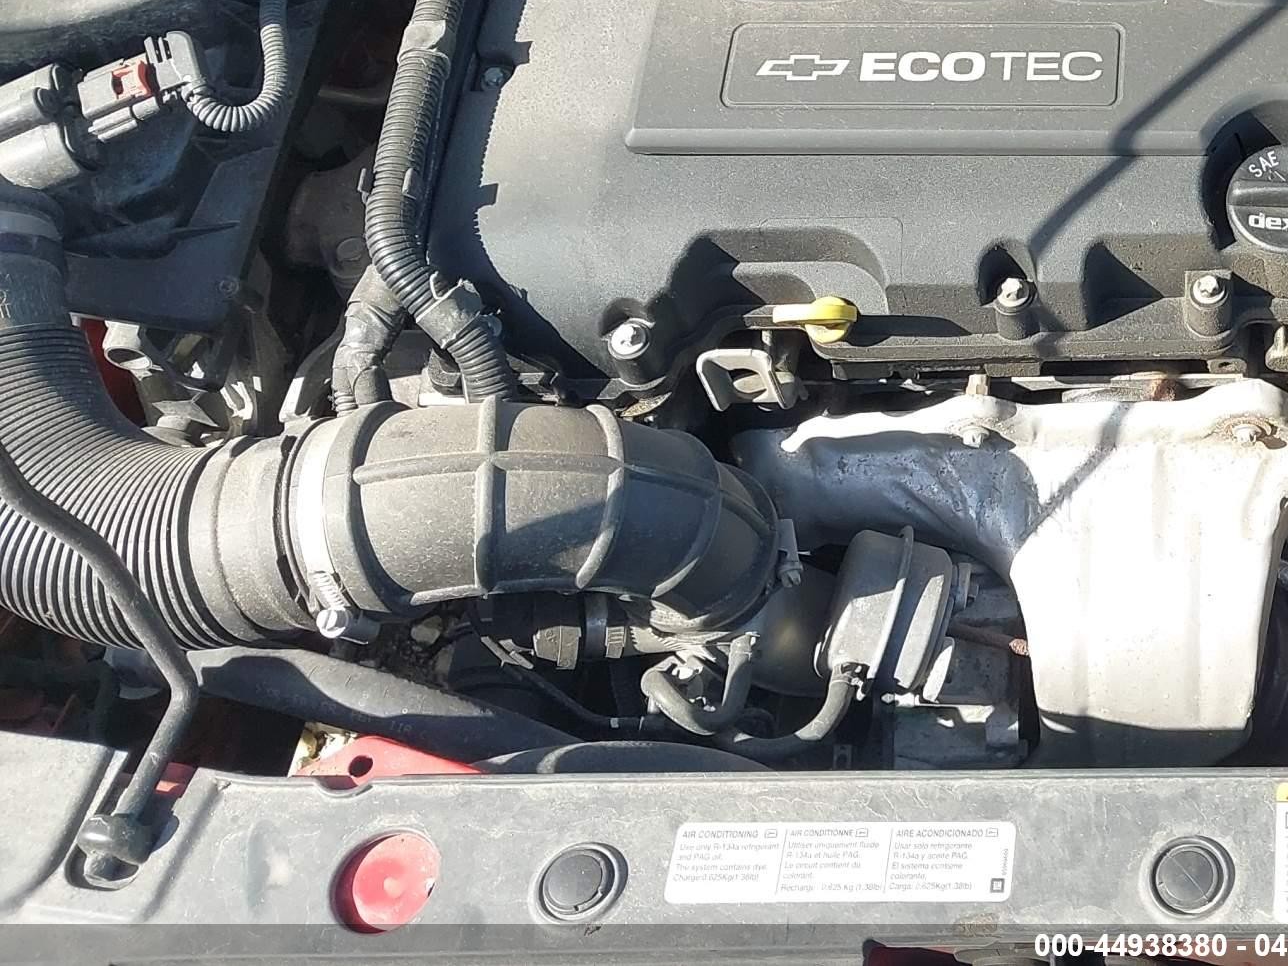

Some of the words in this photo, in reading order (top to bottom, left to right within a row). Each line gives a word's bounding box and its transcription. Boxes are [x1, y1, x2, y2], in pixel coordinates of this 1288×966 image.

[859, 51, 1102, 82] ECOTEC
[1249, 150, 1279, 178] SAE
[698, 830, 759, 838] CONDITIONING
